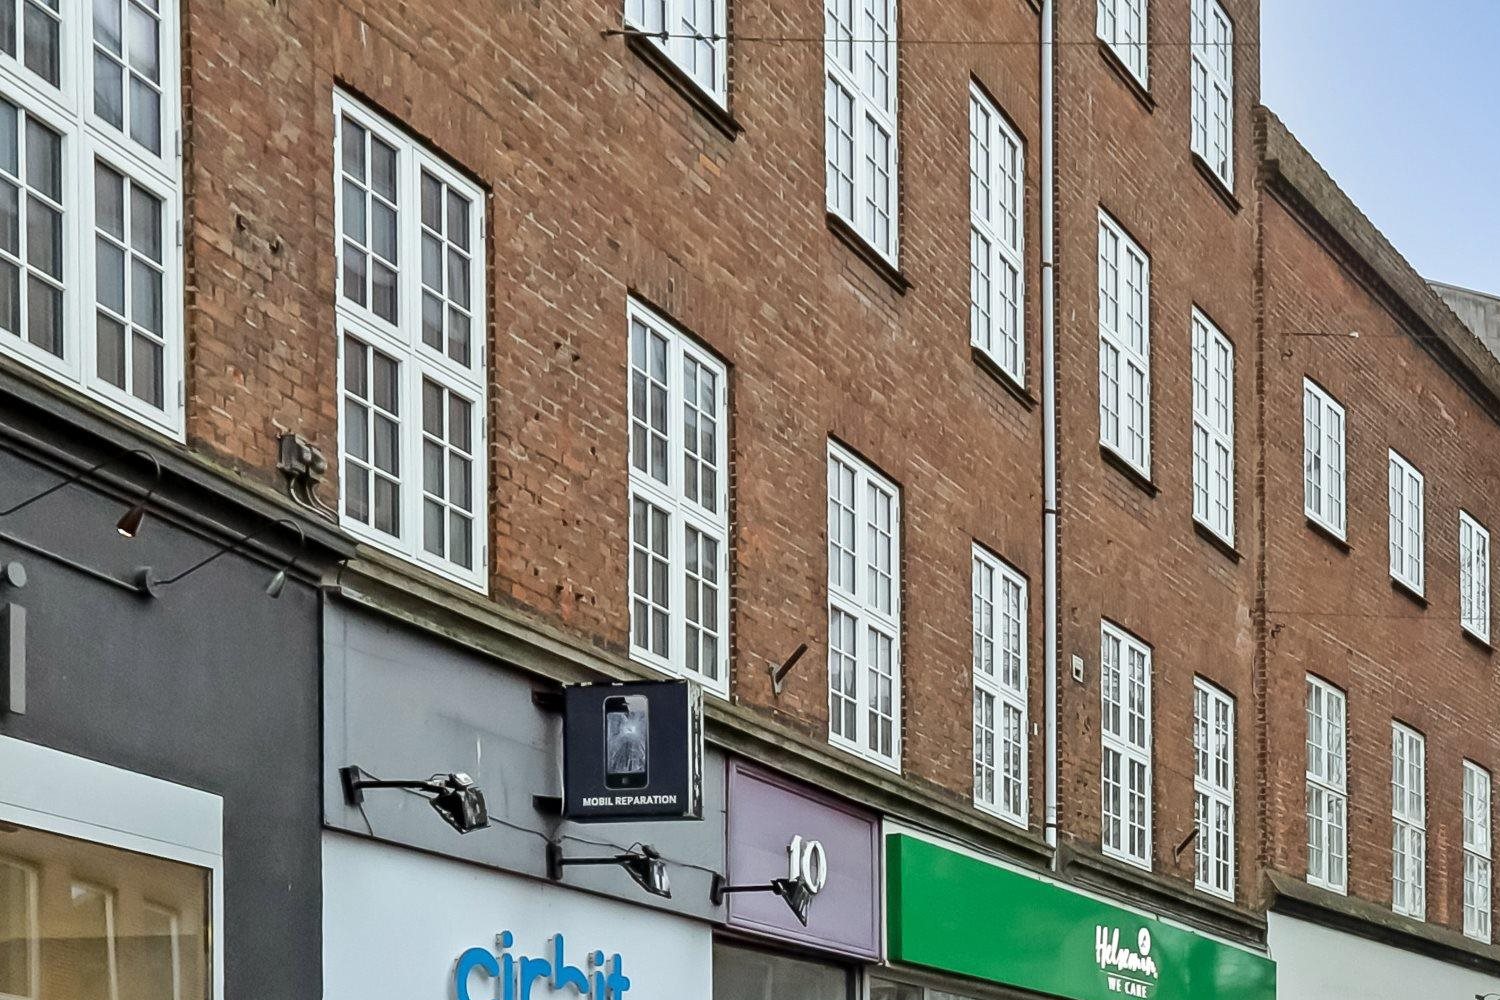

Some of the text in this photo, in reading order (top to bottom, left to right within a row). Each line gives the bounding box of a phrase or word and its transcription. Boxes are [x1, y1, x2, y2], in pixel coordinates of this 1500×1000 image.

[582, 795, 677, 807] MOBIL REPARATION
[789, 835, 827, 894] 10
[1107, 976, 1148, 999] WE CARE
